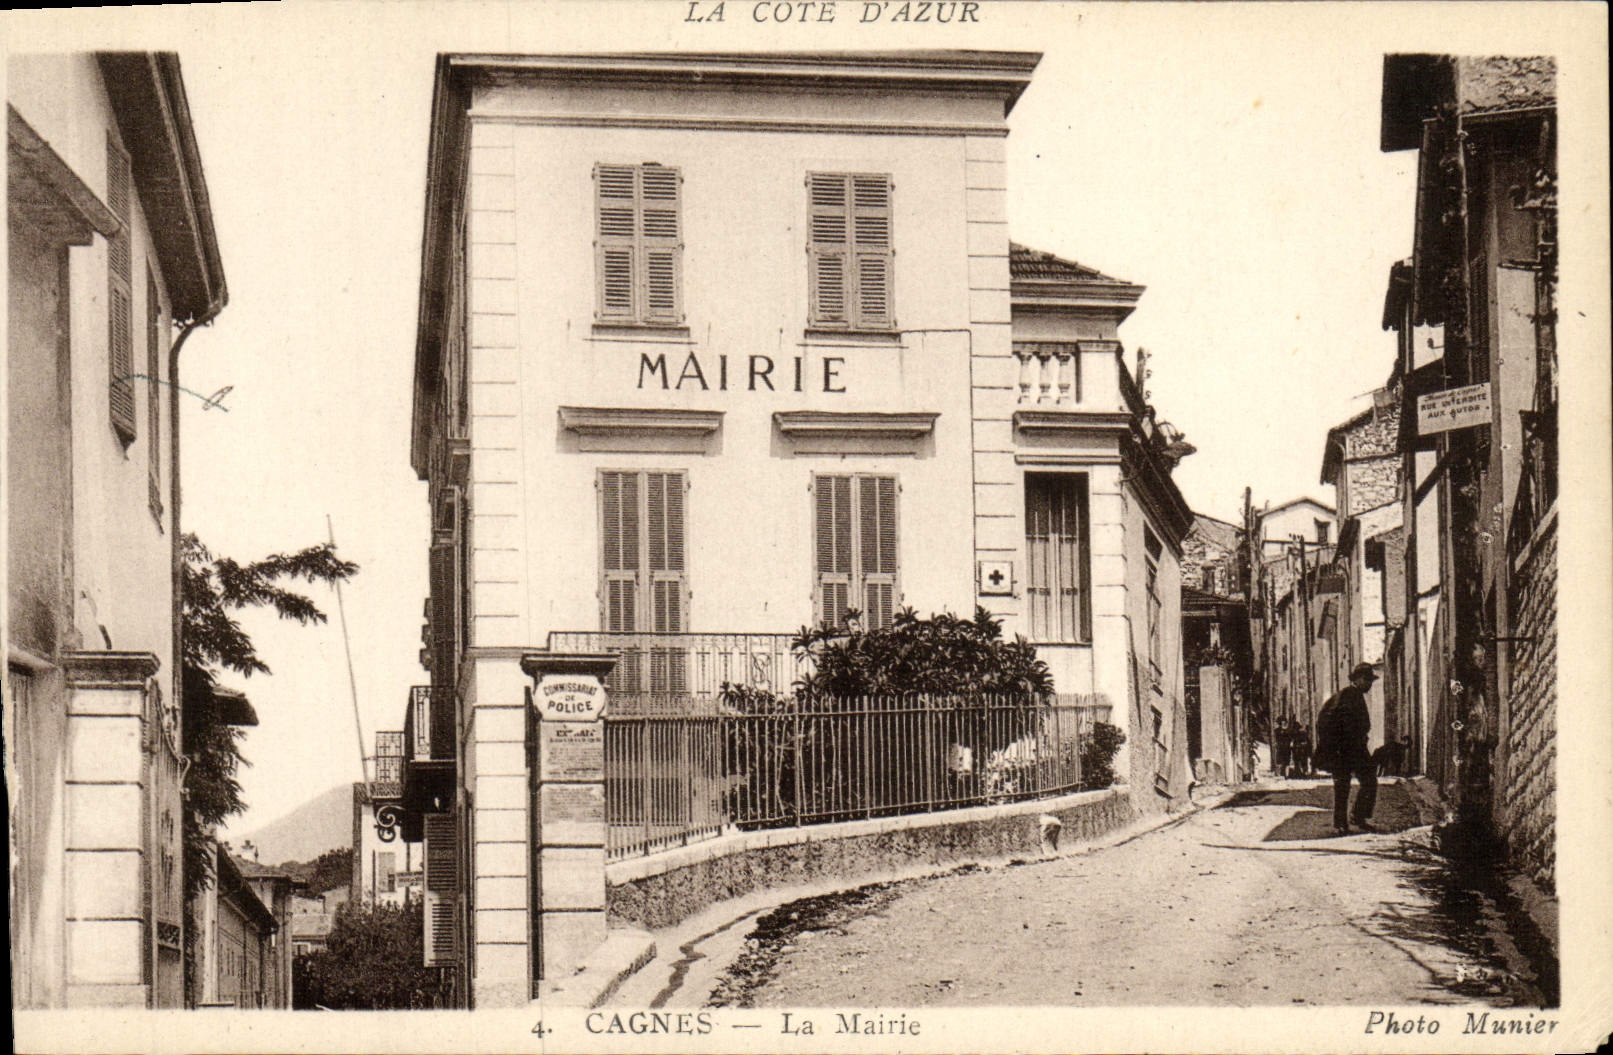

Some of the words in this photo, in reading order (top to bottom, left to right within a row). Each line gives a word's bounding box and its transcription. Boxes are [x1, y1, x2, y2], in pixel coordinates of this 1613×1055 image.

[637, 351, 847, 393] MAIRIE
[1421, 402, 1436, 411] RUE
[1442, 393, 1487, 408] INTERDITE
[1428, 410, 1446, 418] AUX
[543, 682, 598, 696] COMMISSARIAT
[547, 700, 593, 713] POLICE
